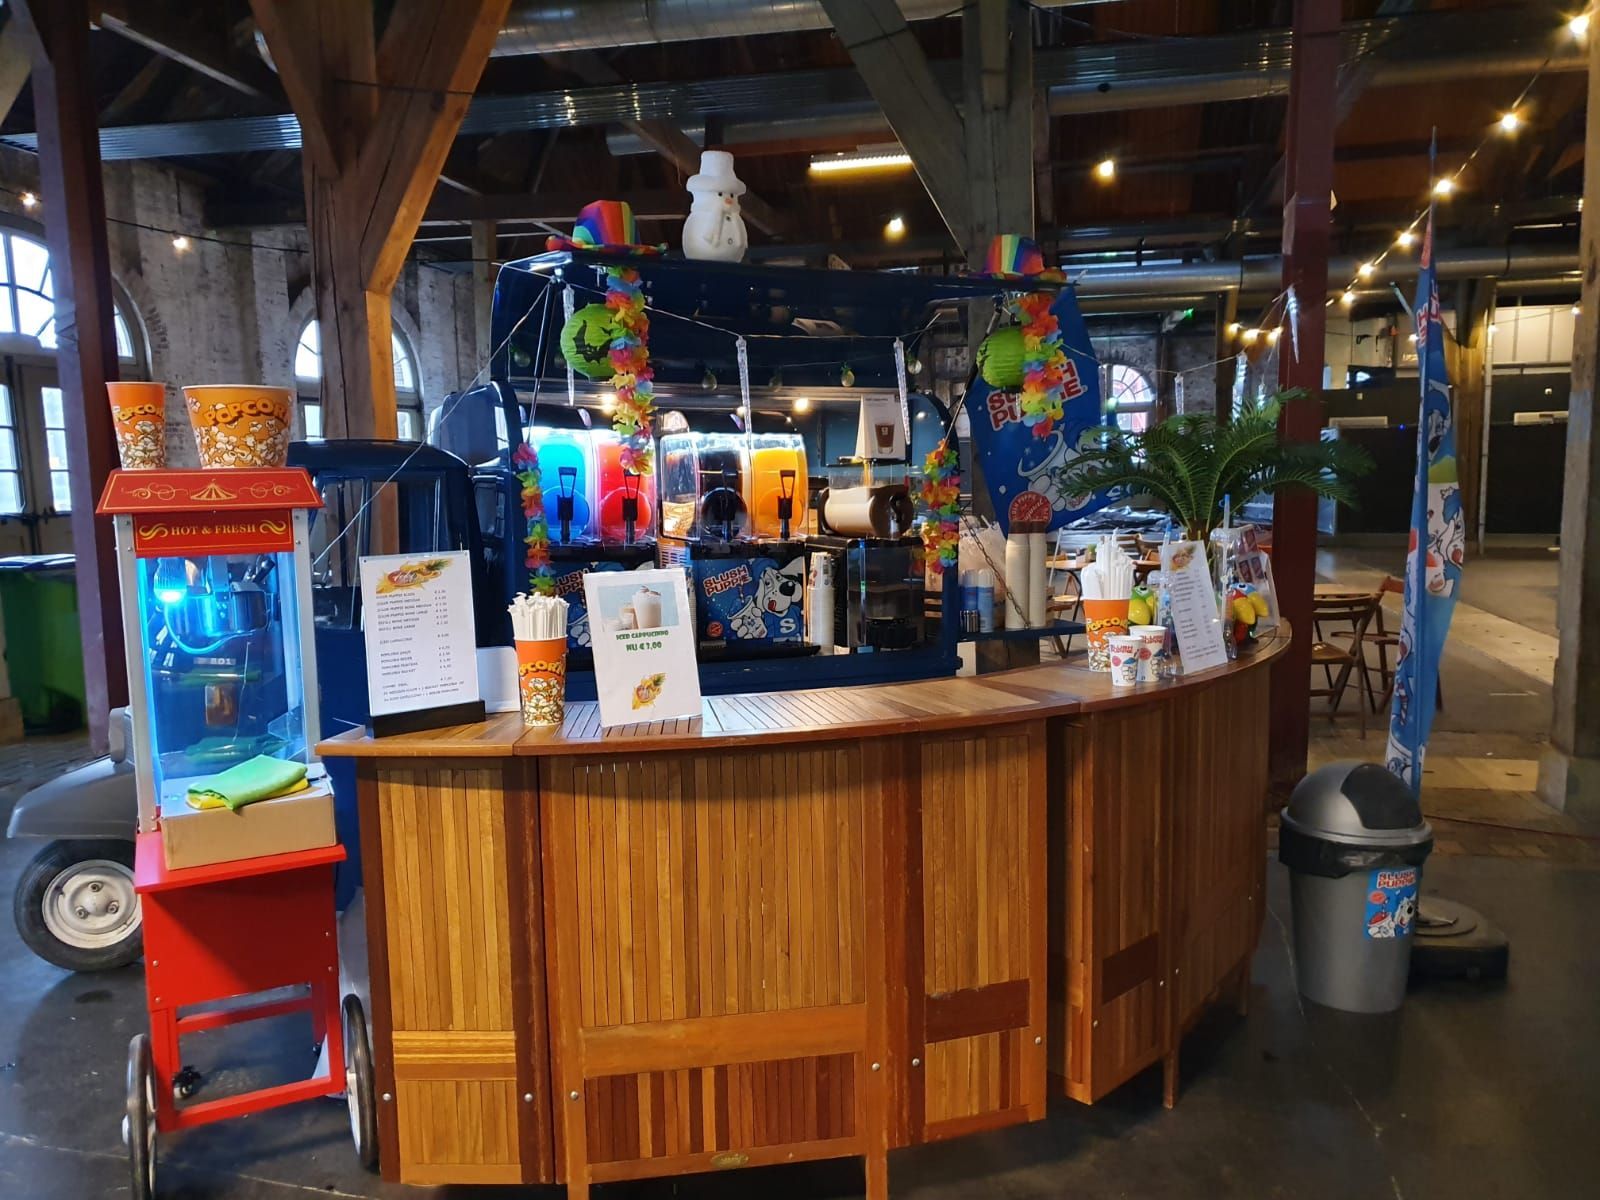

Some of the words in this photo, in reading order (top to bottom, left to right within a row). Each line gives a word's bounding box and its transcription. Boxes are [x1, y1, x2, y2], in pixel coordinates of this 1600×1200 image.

[171, 526, 198, 536] HOT
[201, 526, 211, 535] &
[215, 523, 256, 534] FRESH
[703, 565, 748, 588] SLUSH
[705, 574, 751, 596] PUPPIE
[780, 618, 796, 634] S
[626, 643, 638, 652] NU
[638, 642, 645, 651] €
